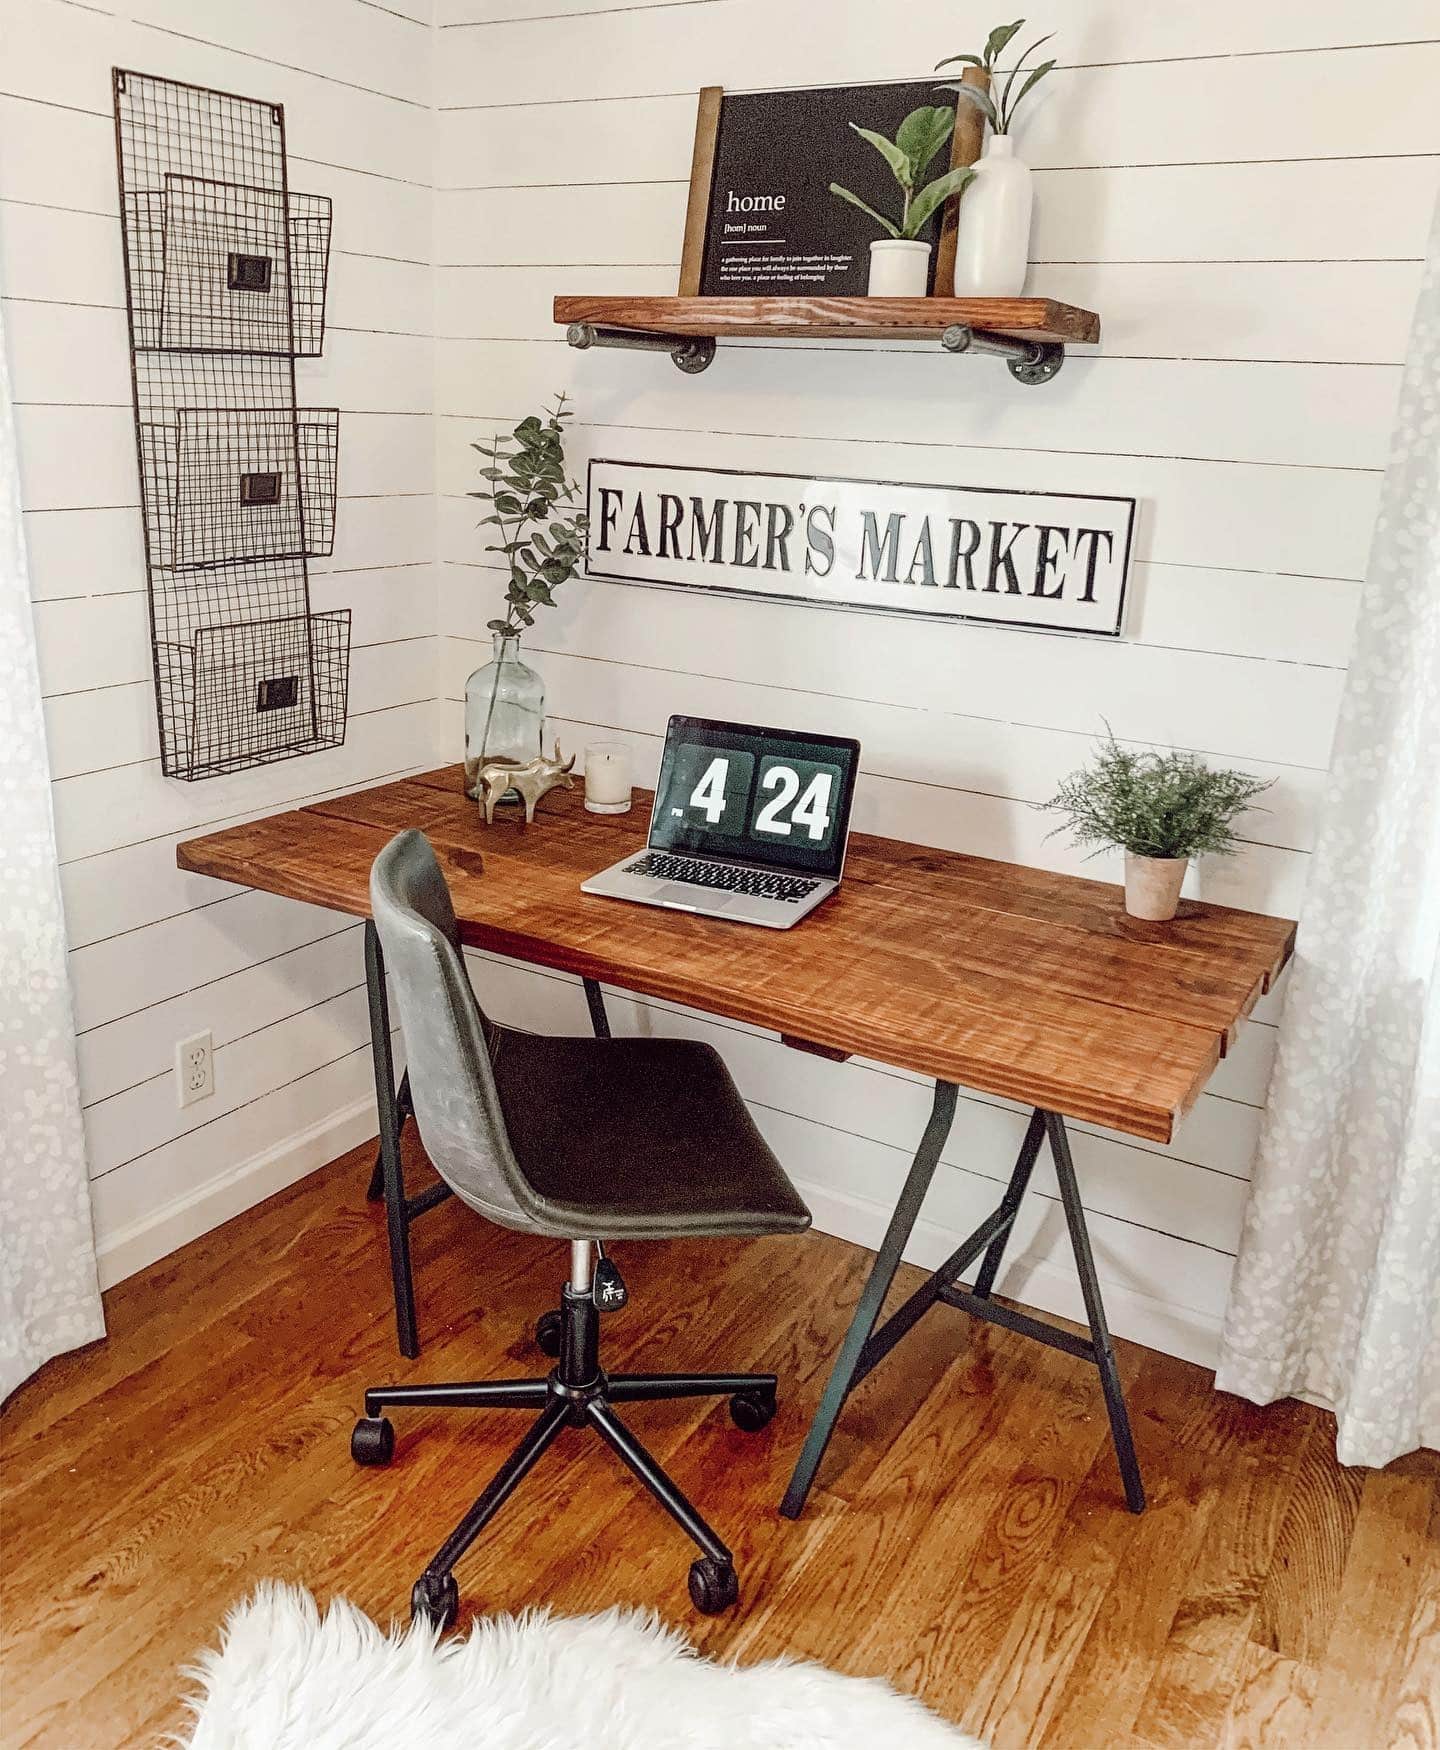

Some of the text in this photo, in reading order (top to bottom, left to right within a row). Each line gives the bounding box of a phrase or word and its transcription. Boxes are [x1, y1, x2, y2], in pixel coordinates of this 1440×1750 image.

[726, 191, 786, 212] home
[596, 487, 1114, 603] FARMER'S MARKET
[690, 758, 729, 824] 4
[755, 765, 833, 841] 24
